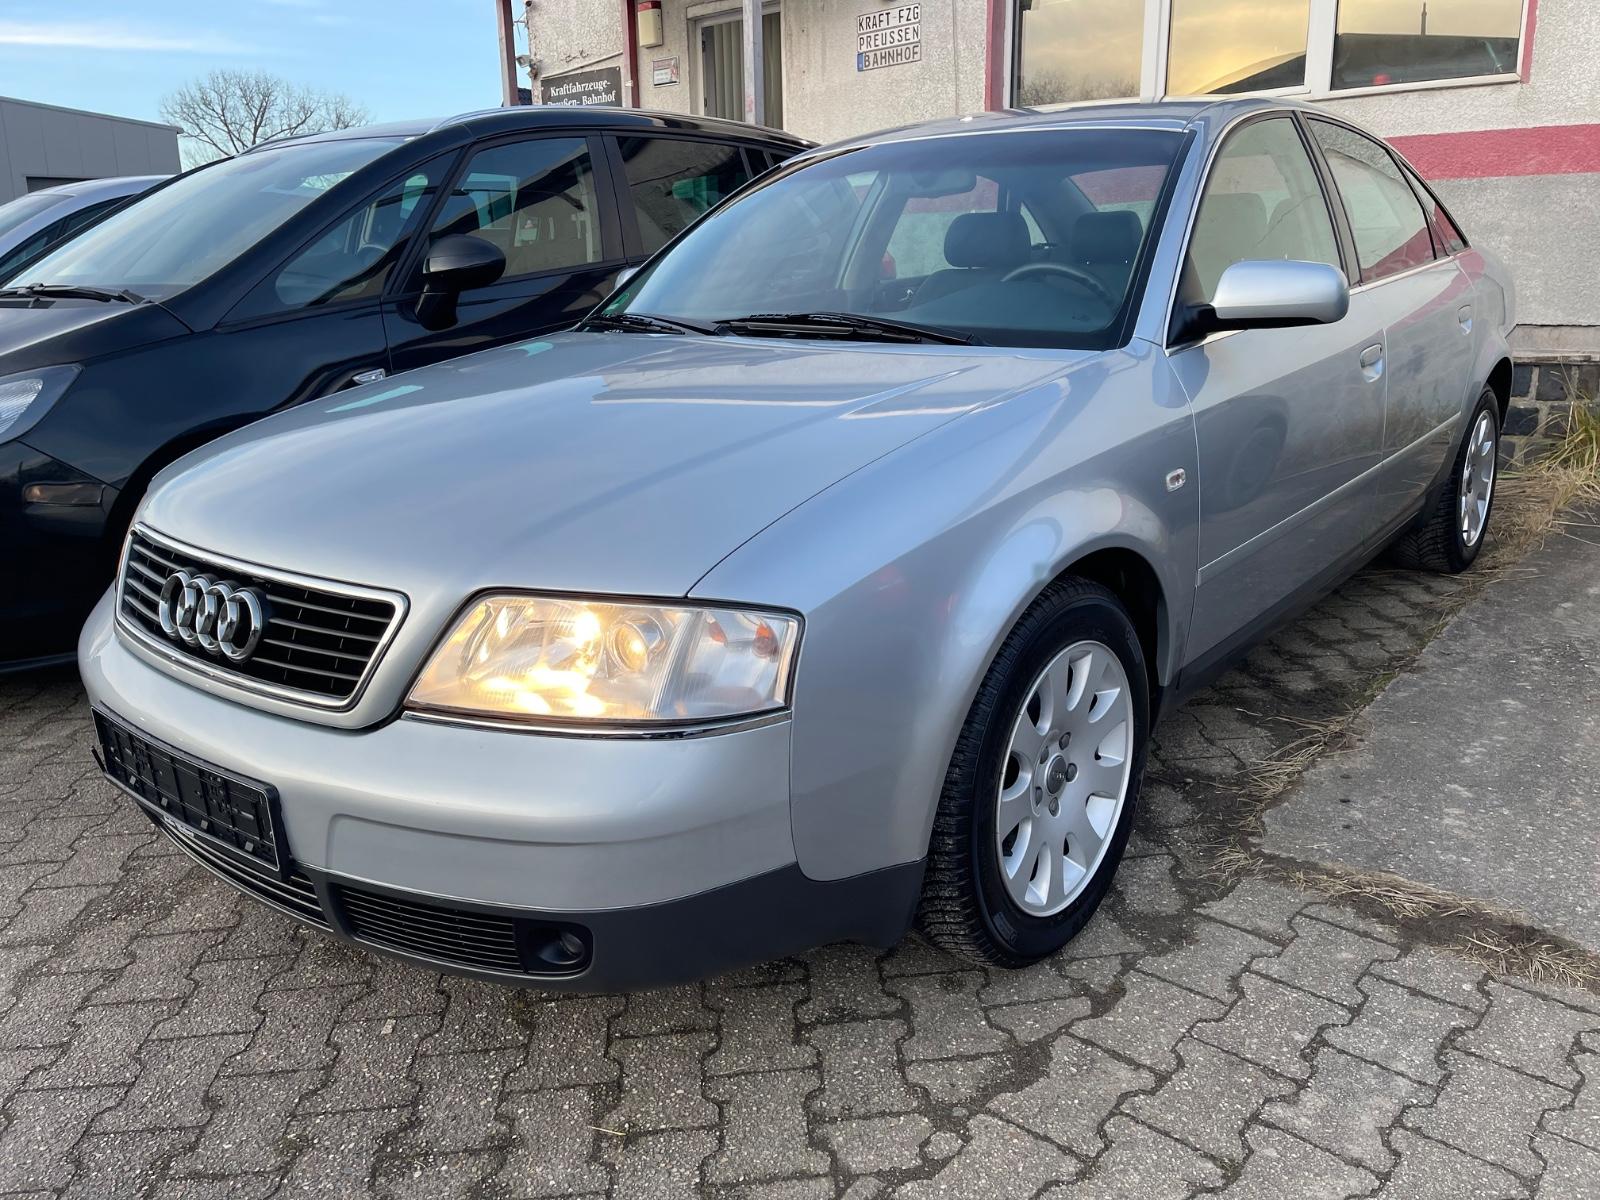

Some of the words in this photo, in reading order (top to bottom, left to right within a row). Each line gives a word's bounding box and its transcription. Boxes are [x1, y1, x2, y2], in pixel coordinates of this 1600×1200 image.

[859, 25, 919, 50] PREUSSEN
[864, 45, 919, 68] BAHNHOF
[550, 80, 611, 97] Kraftfahrzeuge-
[582, 90, 617, 106] Bahnhof
